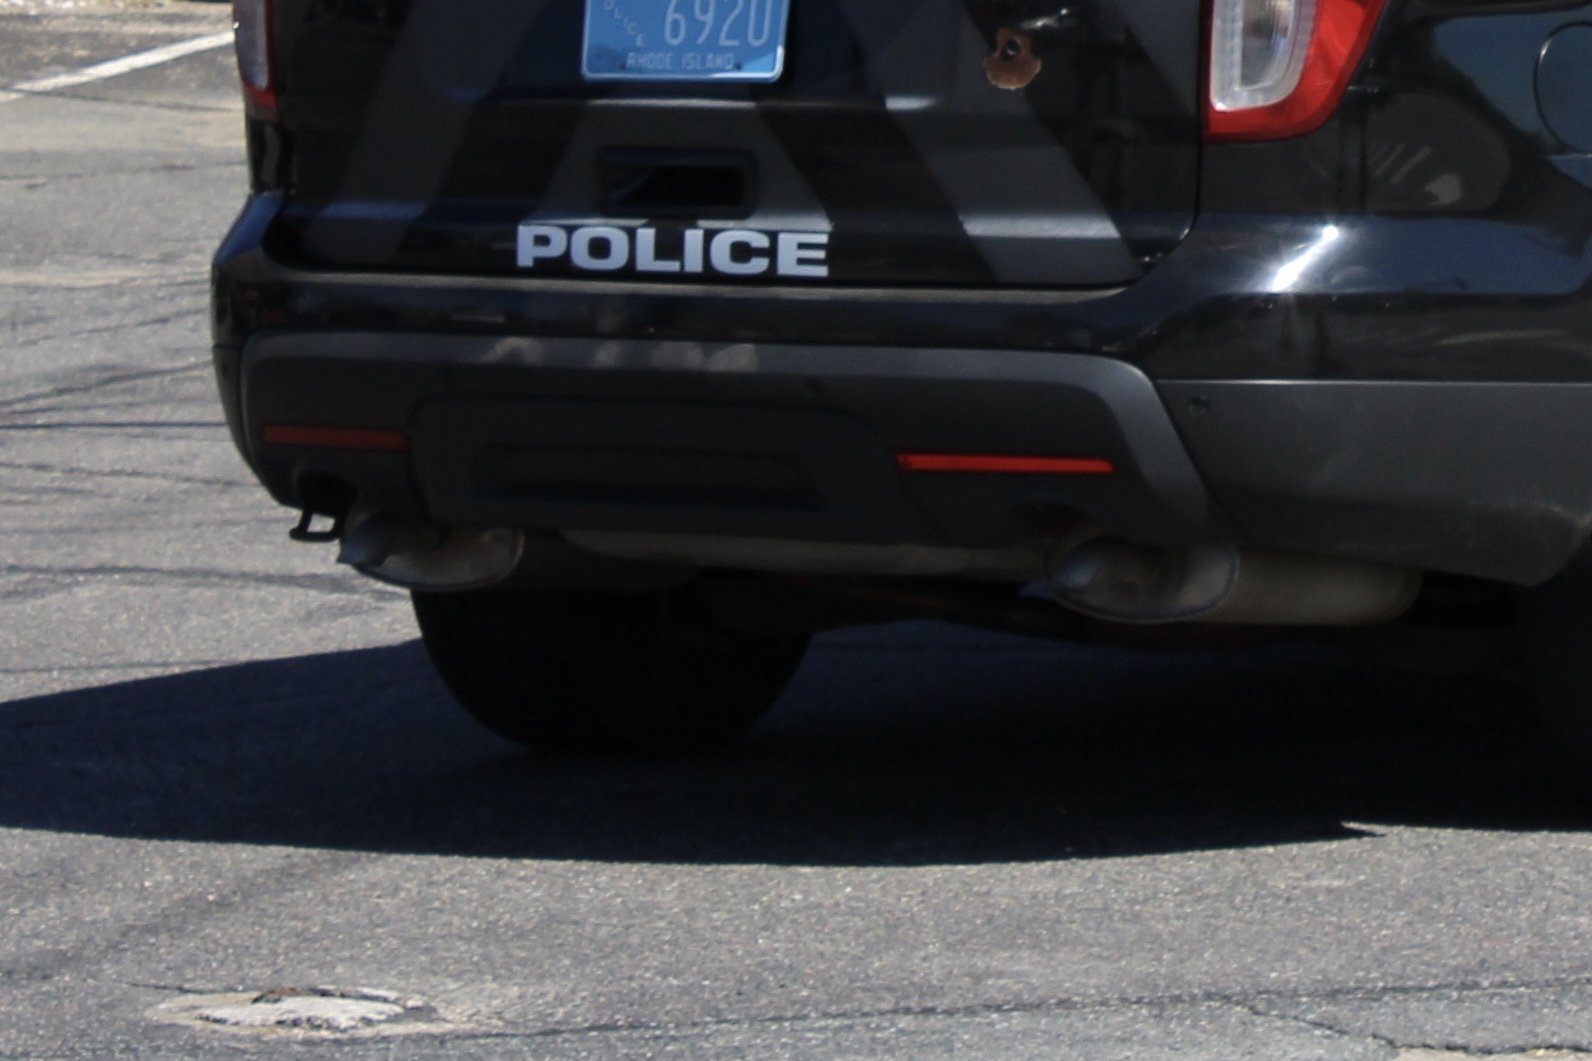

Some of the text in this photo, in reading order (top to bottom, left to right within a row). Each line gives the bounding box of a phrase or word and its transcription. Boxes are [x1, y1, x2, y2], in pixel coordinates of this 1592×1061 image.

[626, 52, 735, 70] RHODE ISLAND
[516, 224, 829, 277] POLICE
